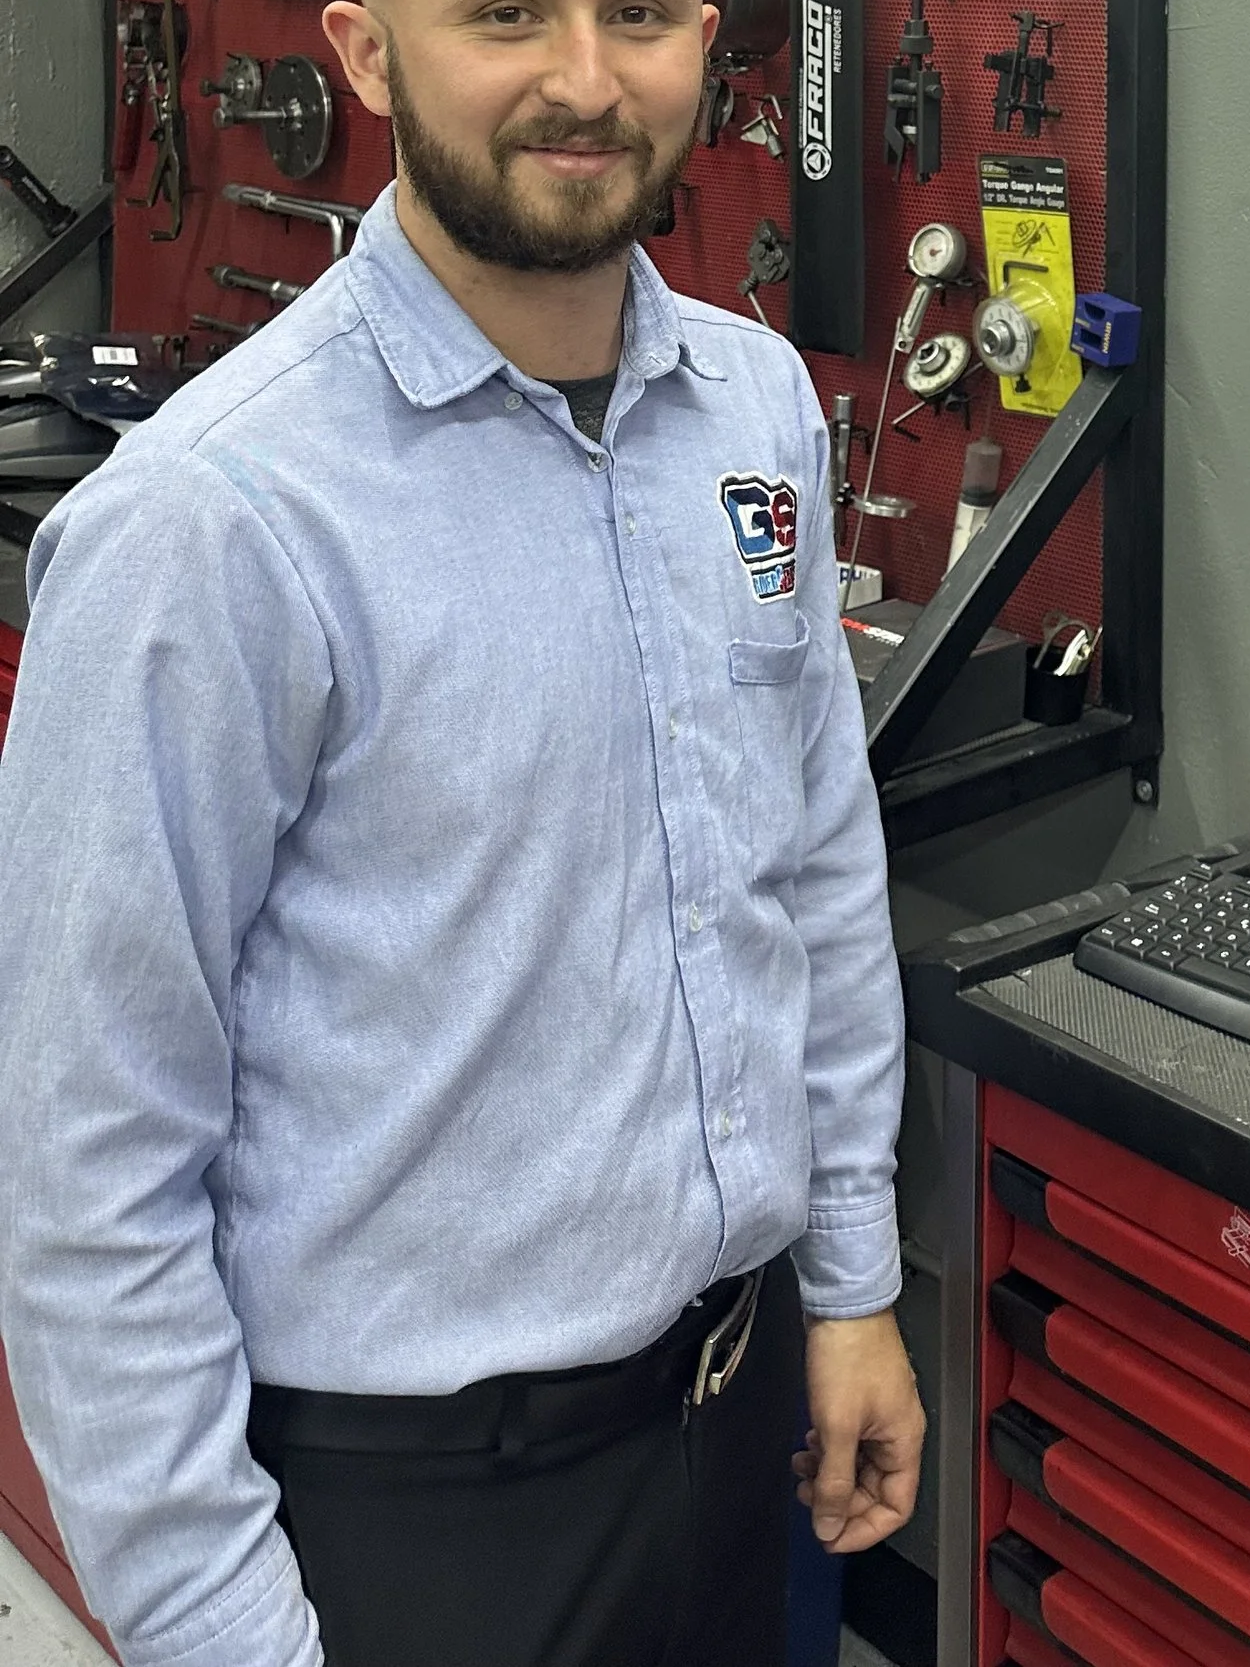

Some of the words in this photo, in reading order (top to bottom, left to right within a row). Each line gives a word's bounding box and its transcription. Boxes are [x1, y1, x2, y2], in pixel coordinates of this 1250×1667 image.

[807, 0, 824, 141] FRACO
[833, 8, 842, 74] RETENEDORES
[982, 179, 1008, 191] Torque
[1036, 183, 1064, 194] Angular
